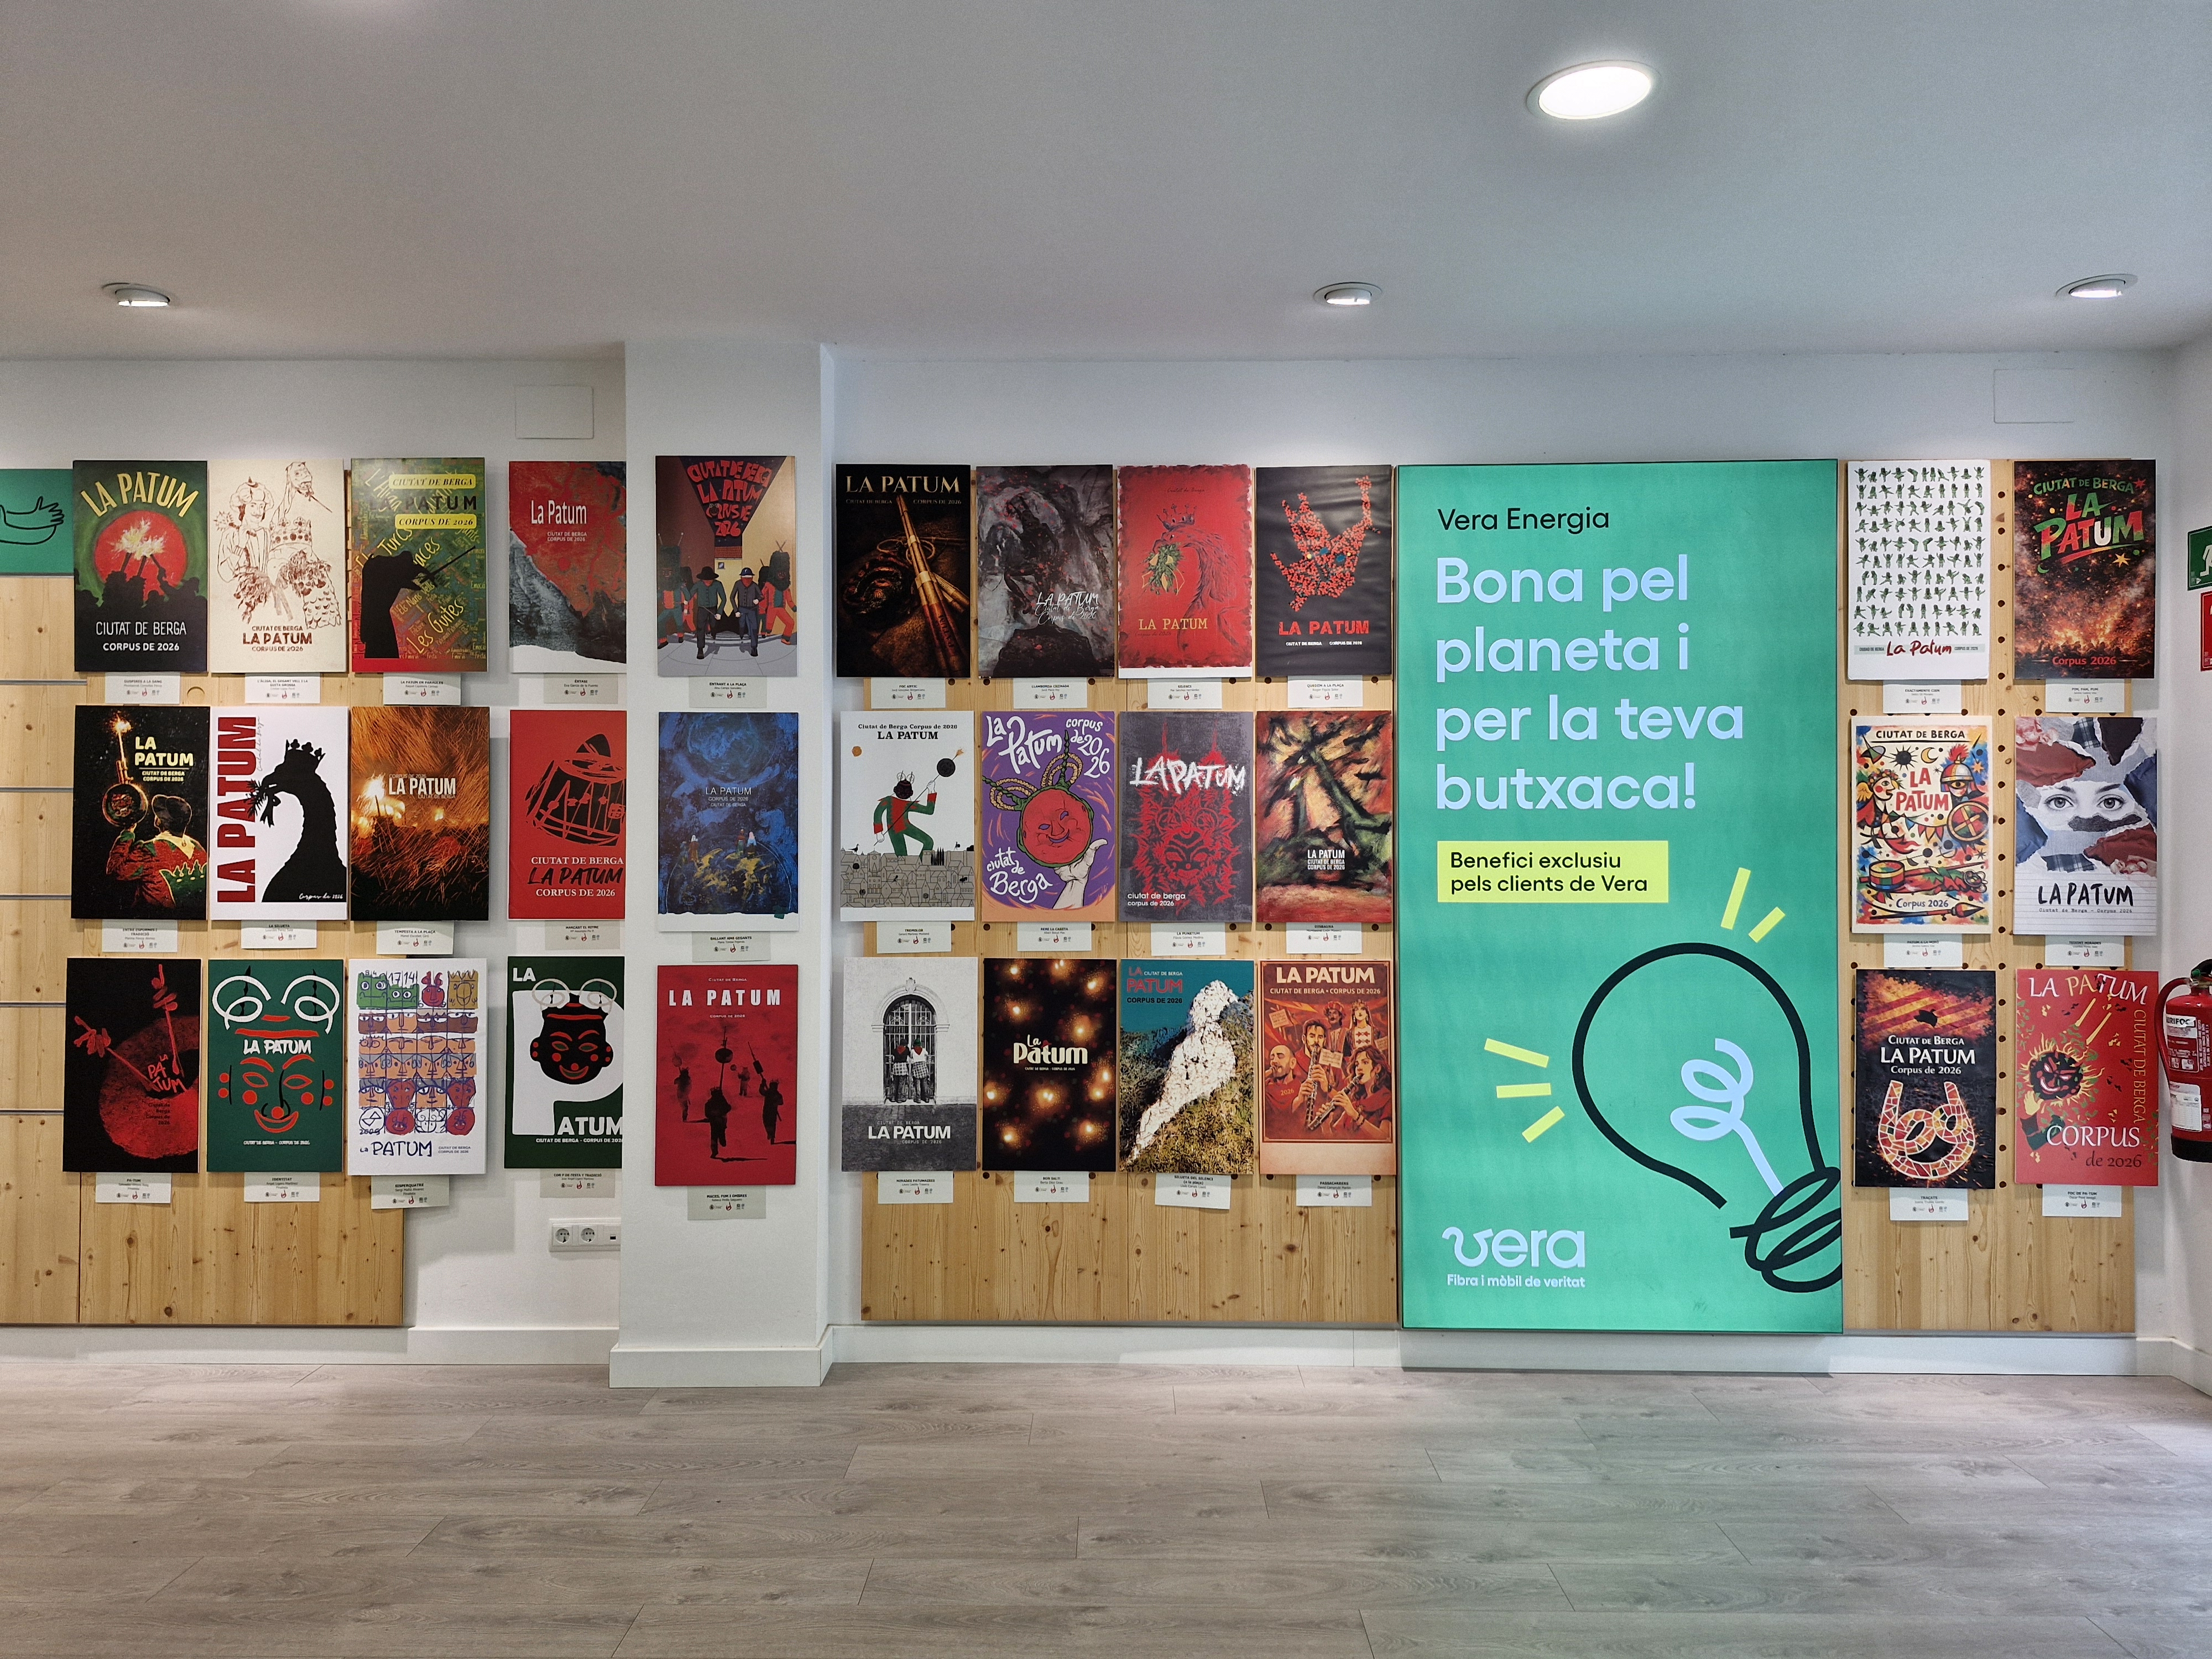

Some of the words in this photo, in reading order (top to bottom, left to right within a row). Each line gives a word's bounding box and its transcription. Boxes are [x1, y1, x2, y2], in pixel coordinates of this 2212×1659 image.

[697, 486, 719, 503] LA
[722, 480, 762, 502] PATUM
[846, 476, 873, 493] LA
[881, 476, 960, 493] PATUM
[2034, 478, 2077, 496] CIUTAT
[2093, 478, 2134, 494] BERGA
[81, 481, 116, 517] LA
[117, 471, 199, 518] PATUM
[531, 500, 543, 524] La
[548, 500, 587, 524] Patum
[2065, 493, 2111, 520] LA
[1437, 508, 1498, 530] Vera
[1507, 507, 1609, 535] Energia
[2033, 511, 2144, 562] PATUM
[1437, 557, 1583, 603] Bona
[1603, 554, 1688, 612] pel
[1036, 592, 1052, 606] LA
[1057, 592, 1098, 606] PATUM
[96, 622, 131, 635] CIUTAT
[135, 622, 147, 635] DE
[153, 622, 186, 635] BERGA
[1139, 619, 1156, 630] LA
[1162, 619, 1208, 629] PATUM
[1279, 622, 1301, 635] LA
[1309, 620, 1369, 634] PATUM
[103, 643, 140, 651] CORPUS
[156, 643, 179, 651] 2026
[243, 633, 260, 644] LA
[264, 633, 312, 645] PATUM
[1437, 626, 1659, 682] planeta
[1678, 623, 1689, 670] i
[1886, 641, 1906, 657] La
[1910, 640, 1952, 656] Patum
[2053, 656, 2086, 666] Corpus
[2091, 656, 2116, 665] 2026
[987, 716, 1007, 747] La
[1066, 718, 1103, 734] corpus
[1437, 706, 1531, 751] per
[1549, 695, 1598, 740] la
[1615, 698, 1743, 740] teva
[897, 731, 938, 739] PATUM
[1071, 729, 1083, 743] de
[1876, 730, 1912, 739] CIUTAT
[1931, 730, 1965, 739] BERGA
[135, 737, 156, 750] LA
[999, 716, 1062, 774] Patum
[135, 753, 194, 766] PATUM
[218, 717, 256, 847] PATUM
[1130, 757, 1168, 790] LA
[1167, 764, 1245, 795] PATUM
[1910, 768, 1932, 788] LA
[389, 779, 405, 795] LA
[409, 778, 456, 795] PATUM
[1437, 763, 1695, 810] butxaca!
[1896, 791, 1949, 812] PATUM
[987, 847, 1019, 872] ciutat
[1011, 860, 1025, 874] de
[1307, 850, 1317, 858] LA
[1319, 850, 1345, 859] PATUM
[1451, 852, 1533, 869] Benefici
[1539, 852, 1621, 869] exclusiu
[217, 859, 255, 902] LA
[528, 867, 552, 885] LA
[559, 867, 623, 885] PATUM
[989, 872, 1053, 903] Berga
[1451, 875, 1491, 895] pels
[1497, 875, 1563, 893] clients
[1570, 875, 1595, 892] de
[1601, 875, 1647, 892] Vera
[2038, 886, 2062, 905] LA
[2068, 883, 2133, 906] PATUM
[1896, 899, 1926, 909] Corpus
[1928, 899, 1948, 909] 2026
[513, 968, 536, 982] LA
[1128, 967, 1141, 976] LA
[1277, 967, 1302, 983] LA
[1306, 967, 1375, 983] PATUM
[1126, 979, 1183, 993] PATUM
[2028, 978, 2059, 998] LA
[2065, 974, 2148, 1005] PATUM
[669, 990, 692, 1006] LA
[707, 989, 781, 1005] PATUM
[1027, 1034, 1041, 1047] La
[2133, 1009, 2146, 1060] CIUTAT
[243, 1040, 262, 1055] LA
[264, 1040, 311, 1055] PATUM
[1013, 1042, 1088, 1066] Patum
[1880, 1048, 1906, 1064] LA
[1909, 1048, 1975, 1065] PATUM
[148, 1063, 166, 1076] PA
[1891, 1066, 1922, 1076] Corpus
[1938, 1066, 1961, 1074] 2026
[2133, 1062, 2146, 1079] DE
[153, 1078, 185, 1093] TUM
[1280, 1088, 1295, 1096] 2026
[2132, 1081, 2146, 1125] BERGA
[868, 1126, 889, 1139] LA
[893, 1126, 951, 1139] PATUM
[2046, 1125, 2140, 1147] CORPUS
[373, 1141, 432, 1157] PATUM
[2085, 1155, 2103, 1167] de
[2106, 1155, 2142, 1168] 2026
[1442, 1227, 1585, 1269] vera
[1447, 1274, 1478, 1287] Fibra
[1481, 1275, 1484, 1286] i
[1486, 1275, 1522, 1287] mòbil
[1525, 1276, 1541, 1287] de
[1544, 1276, 1585, 1288] veritat
